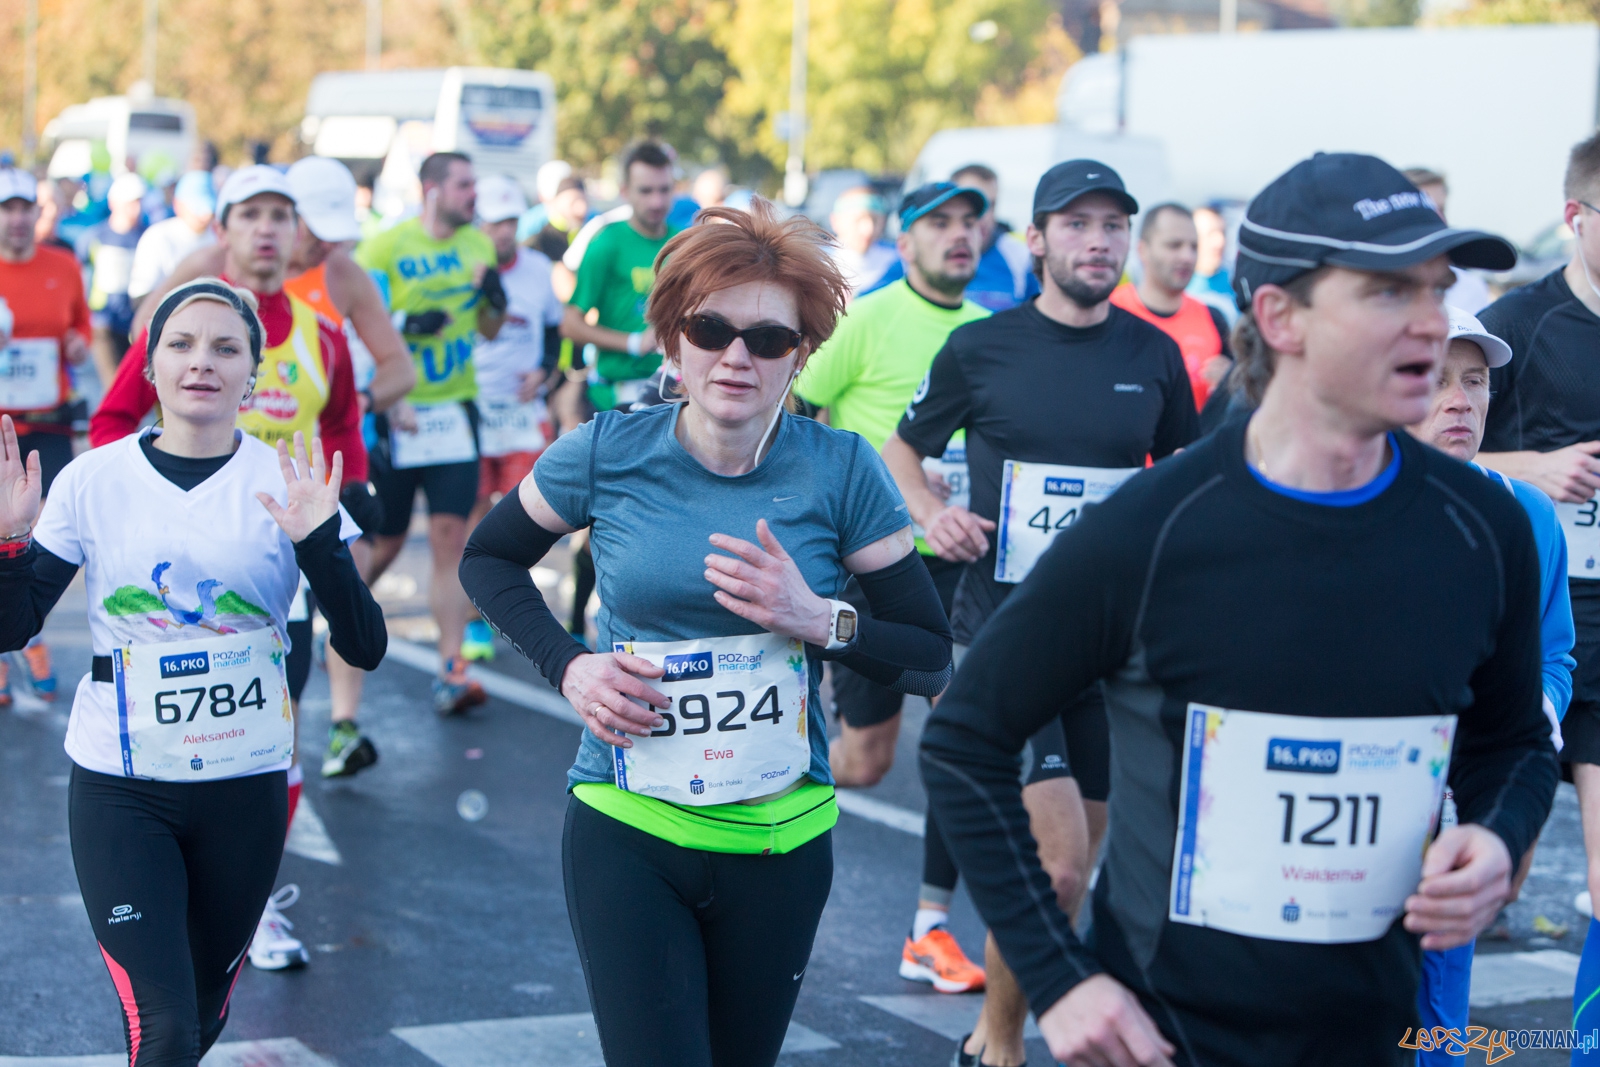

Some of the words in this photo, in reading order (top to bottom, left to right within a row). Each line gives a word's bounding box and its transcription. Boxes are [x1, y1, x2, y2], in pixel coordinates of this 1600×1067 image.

[1574, 499, 1600, 528] 3
[213, 656, 251, 669] maraton
[718, 661, 762, 671] maraton
[154, 676, 267, 725] 6784
[183, 727, 246, 745] Aleksandra
[220, 756, 235, 764] Polski
[704, 749, 734, 761] Ewa
[708, 781, 724, 789] Bank
[725, 778, 743, 787] Polski
[1277, 793, 1381, 847] 1211
[1281, 865, 1368, 881] Waldemar
[108, 912, 142, 925] Kalenji
